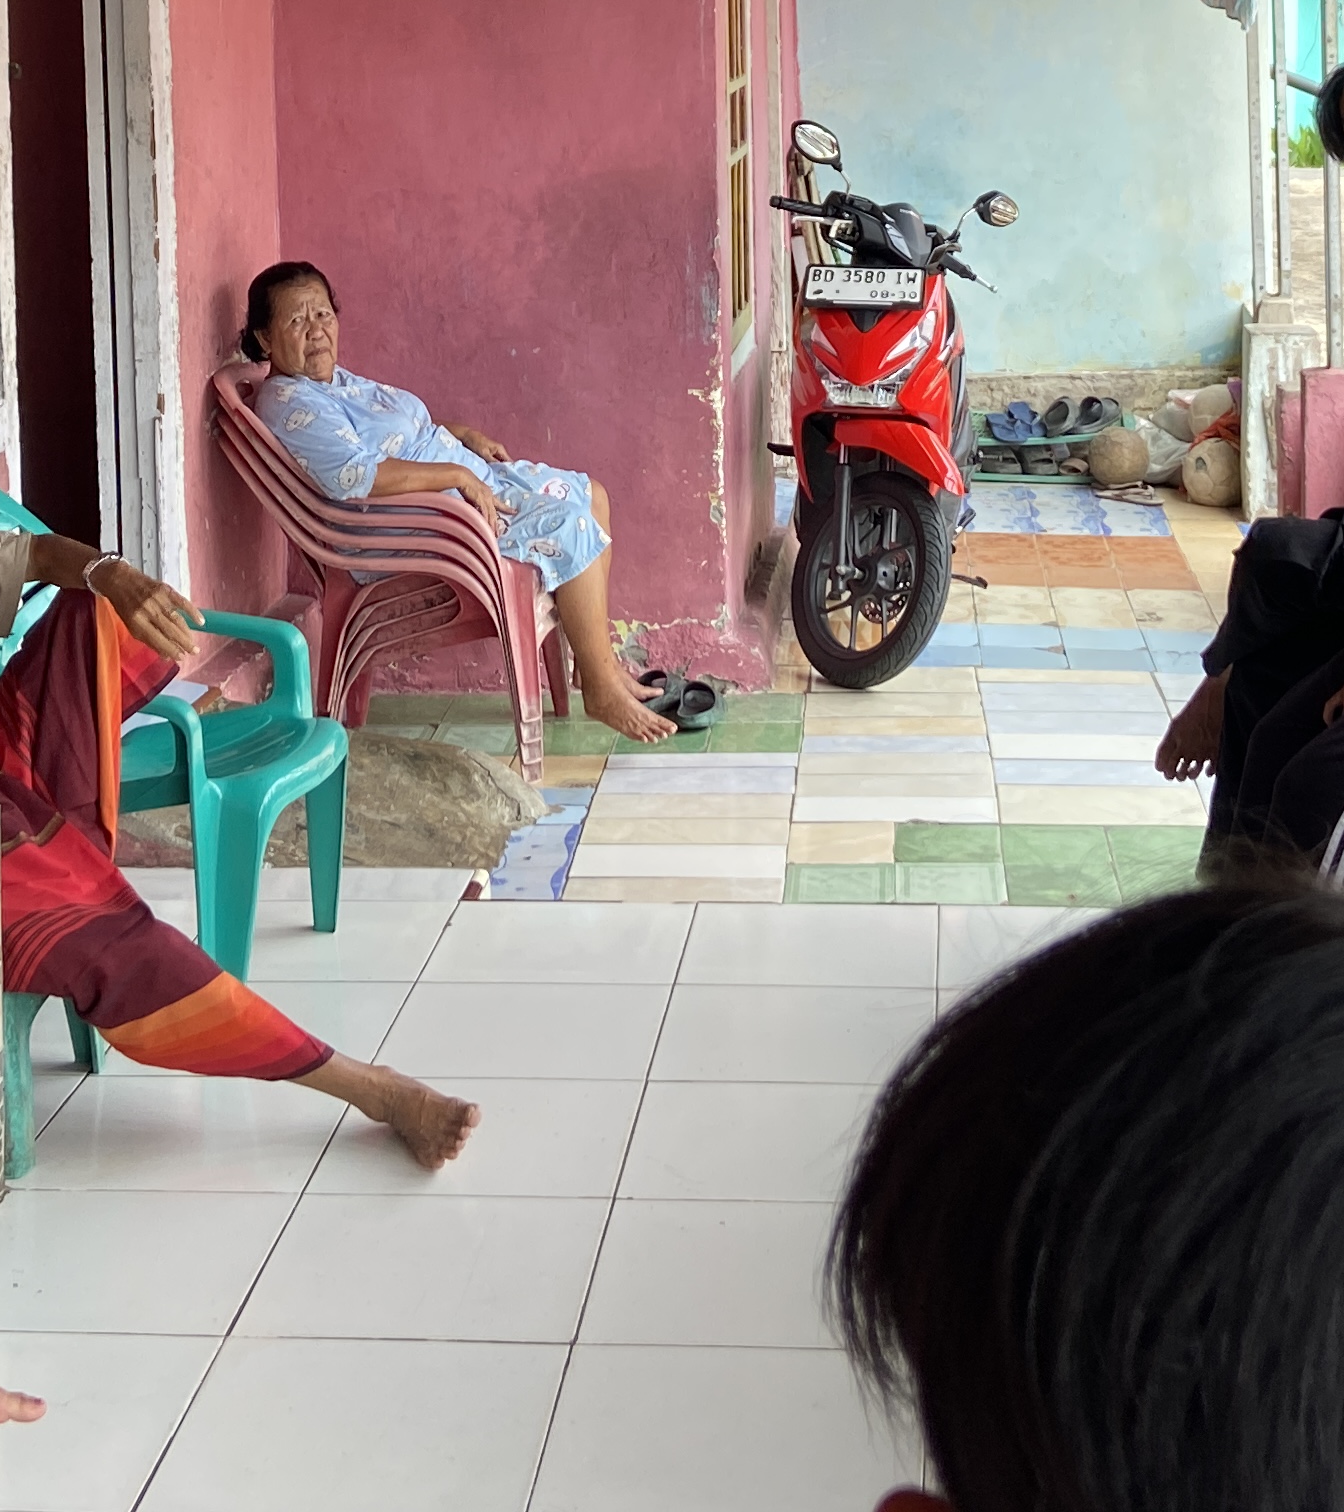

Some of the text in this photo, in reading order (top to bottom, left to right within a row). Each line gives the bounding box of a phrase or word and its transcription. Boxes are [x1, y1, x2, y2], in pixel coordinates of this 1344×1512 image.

[812, 269, 918, 284] BD 3580 IW
[869, 289, 918, 299] 08-30
